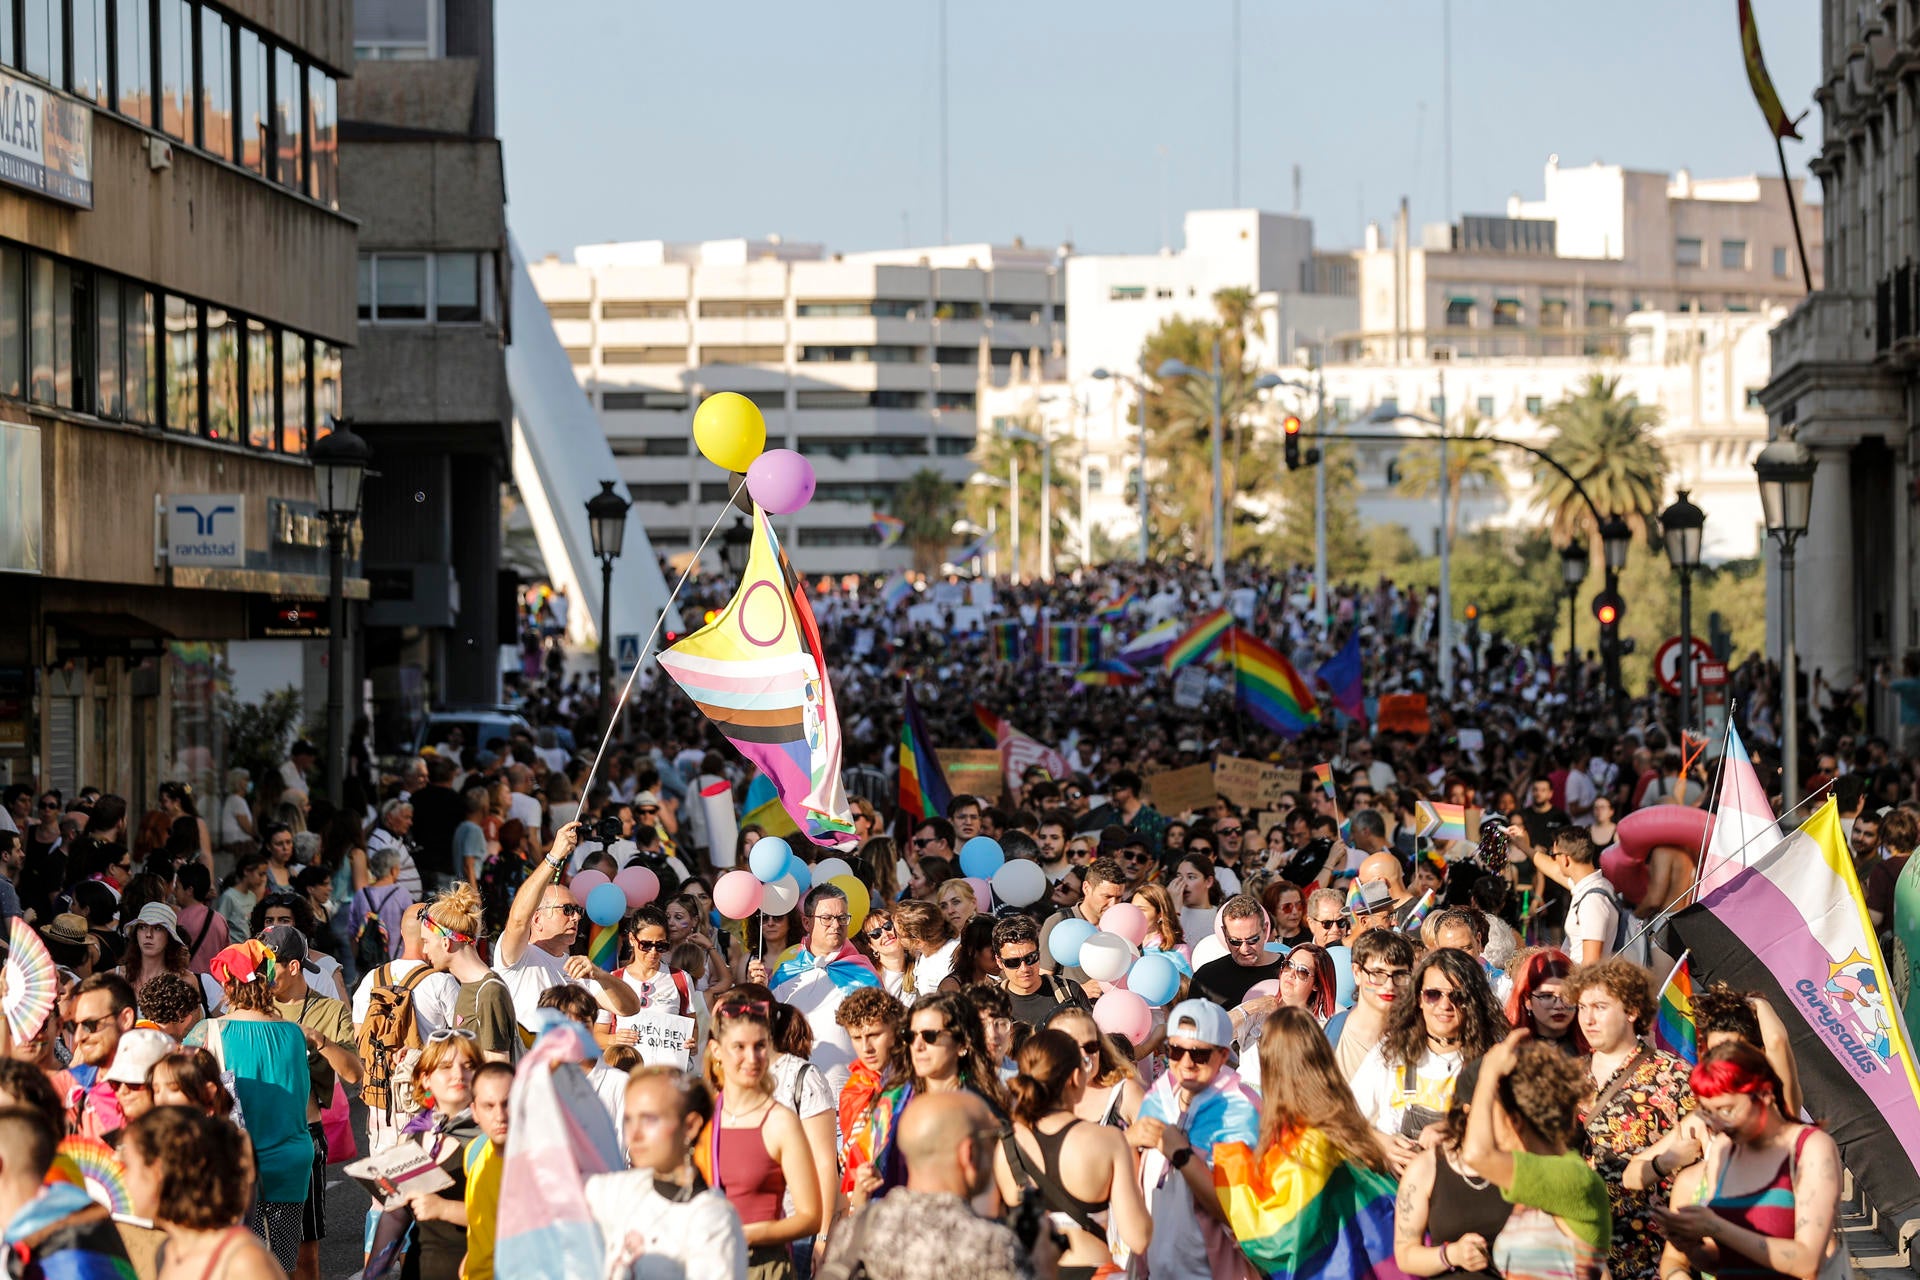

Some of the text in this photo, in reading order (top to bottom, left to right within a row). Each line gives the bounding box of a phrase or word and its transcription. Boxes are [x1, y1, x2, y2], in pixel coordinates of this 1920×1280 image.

[175, 541, 235, 557] randstad
[1796, 979, 1876, 1074] Chrysallis
[665, 1028, 686, 1041] BIEN
[647, 1037, 683, 1051] QUIERE
